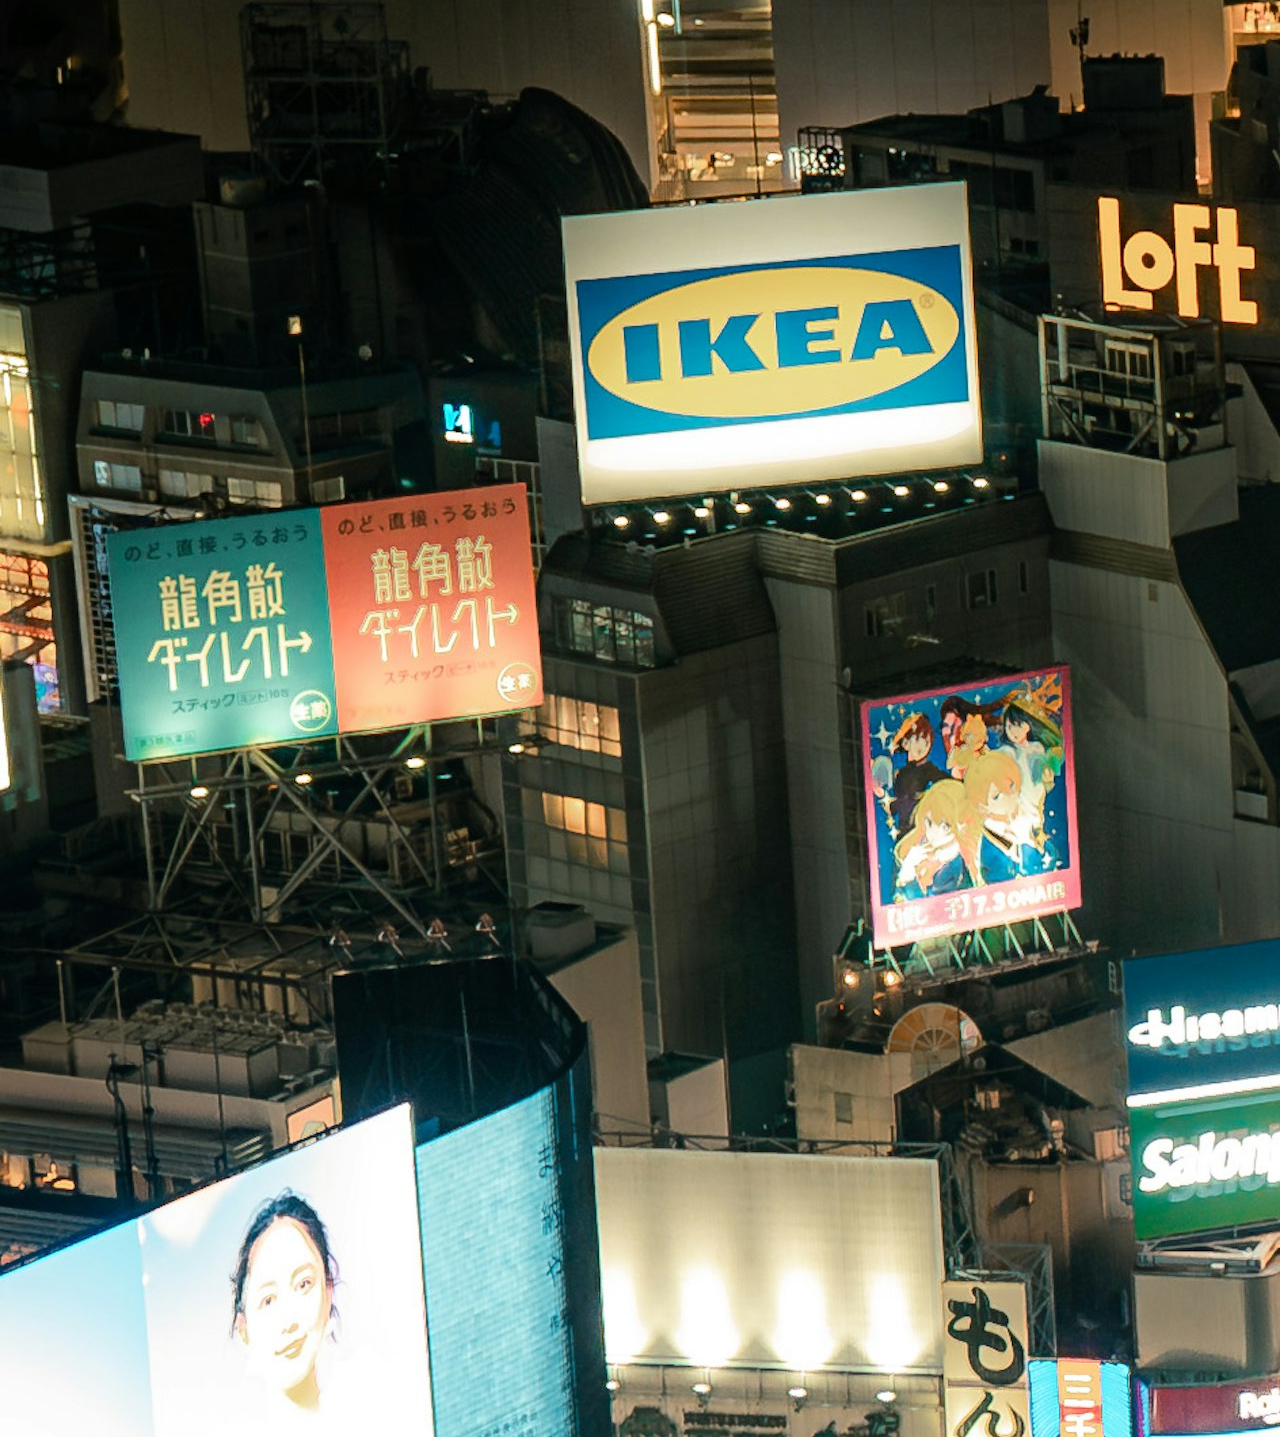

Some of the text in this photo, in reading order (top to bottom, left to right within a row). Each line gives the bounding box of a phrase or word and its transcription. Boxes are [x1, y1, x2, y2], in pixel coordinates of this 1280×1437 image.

[621, 299, 935, 386] IKEA
[123, 524, 309, 562] のど、直接、うるおう
[338, 498, 517, 536] のど、直接、うるおう
[158, 562, 287, 631] 龍角散
[371, 534, 494, 604] 龍角散
[147, 623, 313, 692] ダイレクト
[359, 596, 519, 663] ダイレクト
[172, 693, 236, 714] スティック
